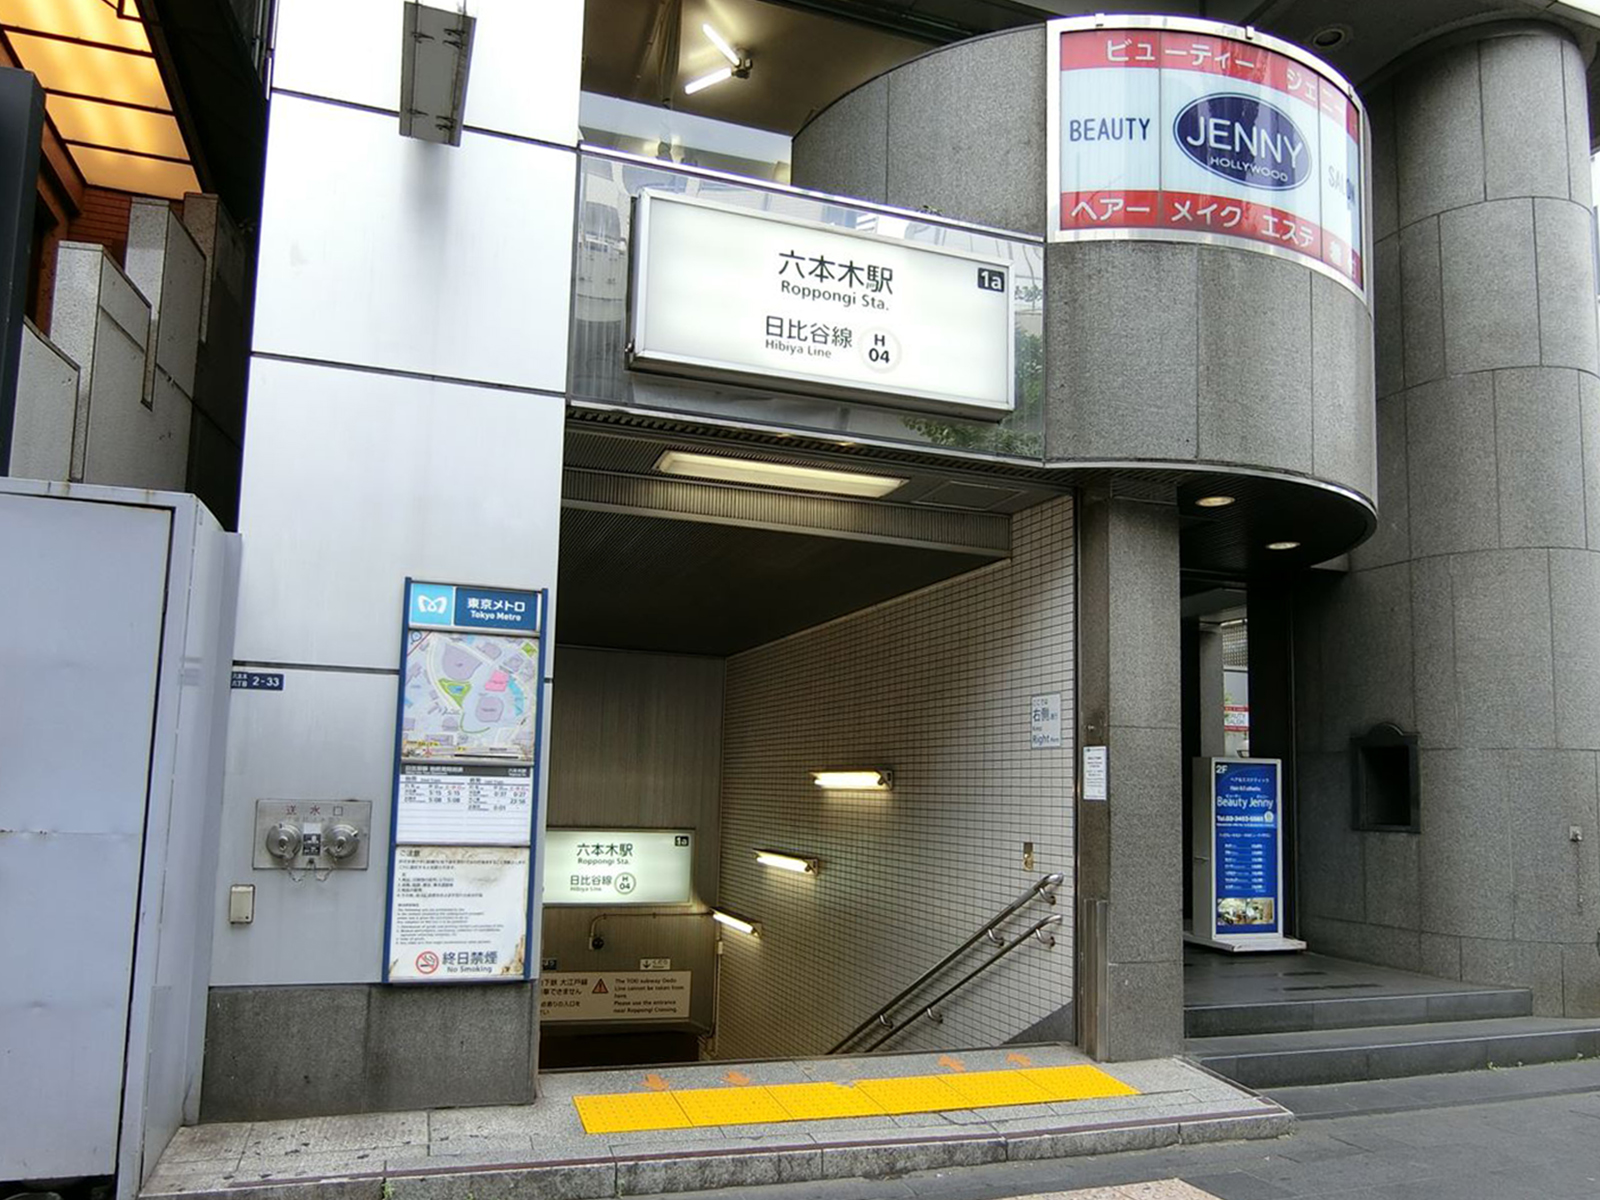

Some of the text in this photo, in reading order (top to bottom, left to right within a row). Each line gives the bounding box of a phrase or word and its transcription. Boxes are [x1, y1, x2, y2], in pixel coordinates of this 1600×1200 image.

[1106, 38, 1254, 69] ビューティー
[1069, 117, 1151, 142] BEAUTY
[1186, 115, 1303, 168] JENNY
[1209, 156, 1289, 183] HOLLYWOOD
[1071, 198, 1314, 248] ヘアー メイク エステ
[778, 250, 894, 295] 六本木駅
[980, 270, 1004, 292] 1a
[780, 280, 890, 312] Roppongi Sta.
[765, 315, 853, 349] 日比谷線
[874, 334, 886, 347] H
[765, 339, 833, 359] Hibiya Line
[868, 347, 890, 364] 04
[467, 597, 526, 612] 東京メトロ
[470, 610, 522, 622] Tokyo Metro
[252, 676, 280, 687] 2-33
[1216, 765, 1228, 774] 2F
[1217, 796, 1274, 810] Beauty Jenny
[676, 837, 688, 846] 1a
[576, 843, 634, 857] 六本木駅
[577, 857, 630, 866] Roppongi Sta.
[570, 875, 612, 886] 日比谷線
[619, 882, 631, 890] 04
[442, 951, 498, 966] 終日禁煙
[460, 965, 493, 974] Smoking
